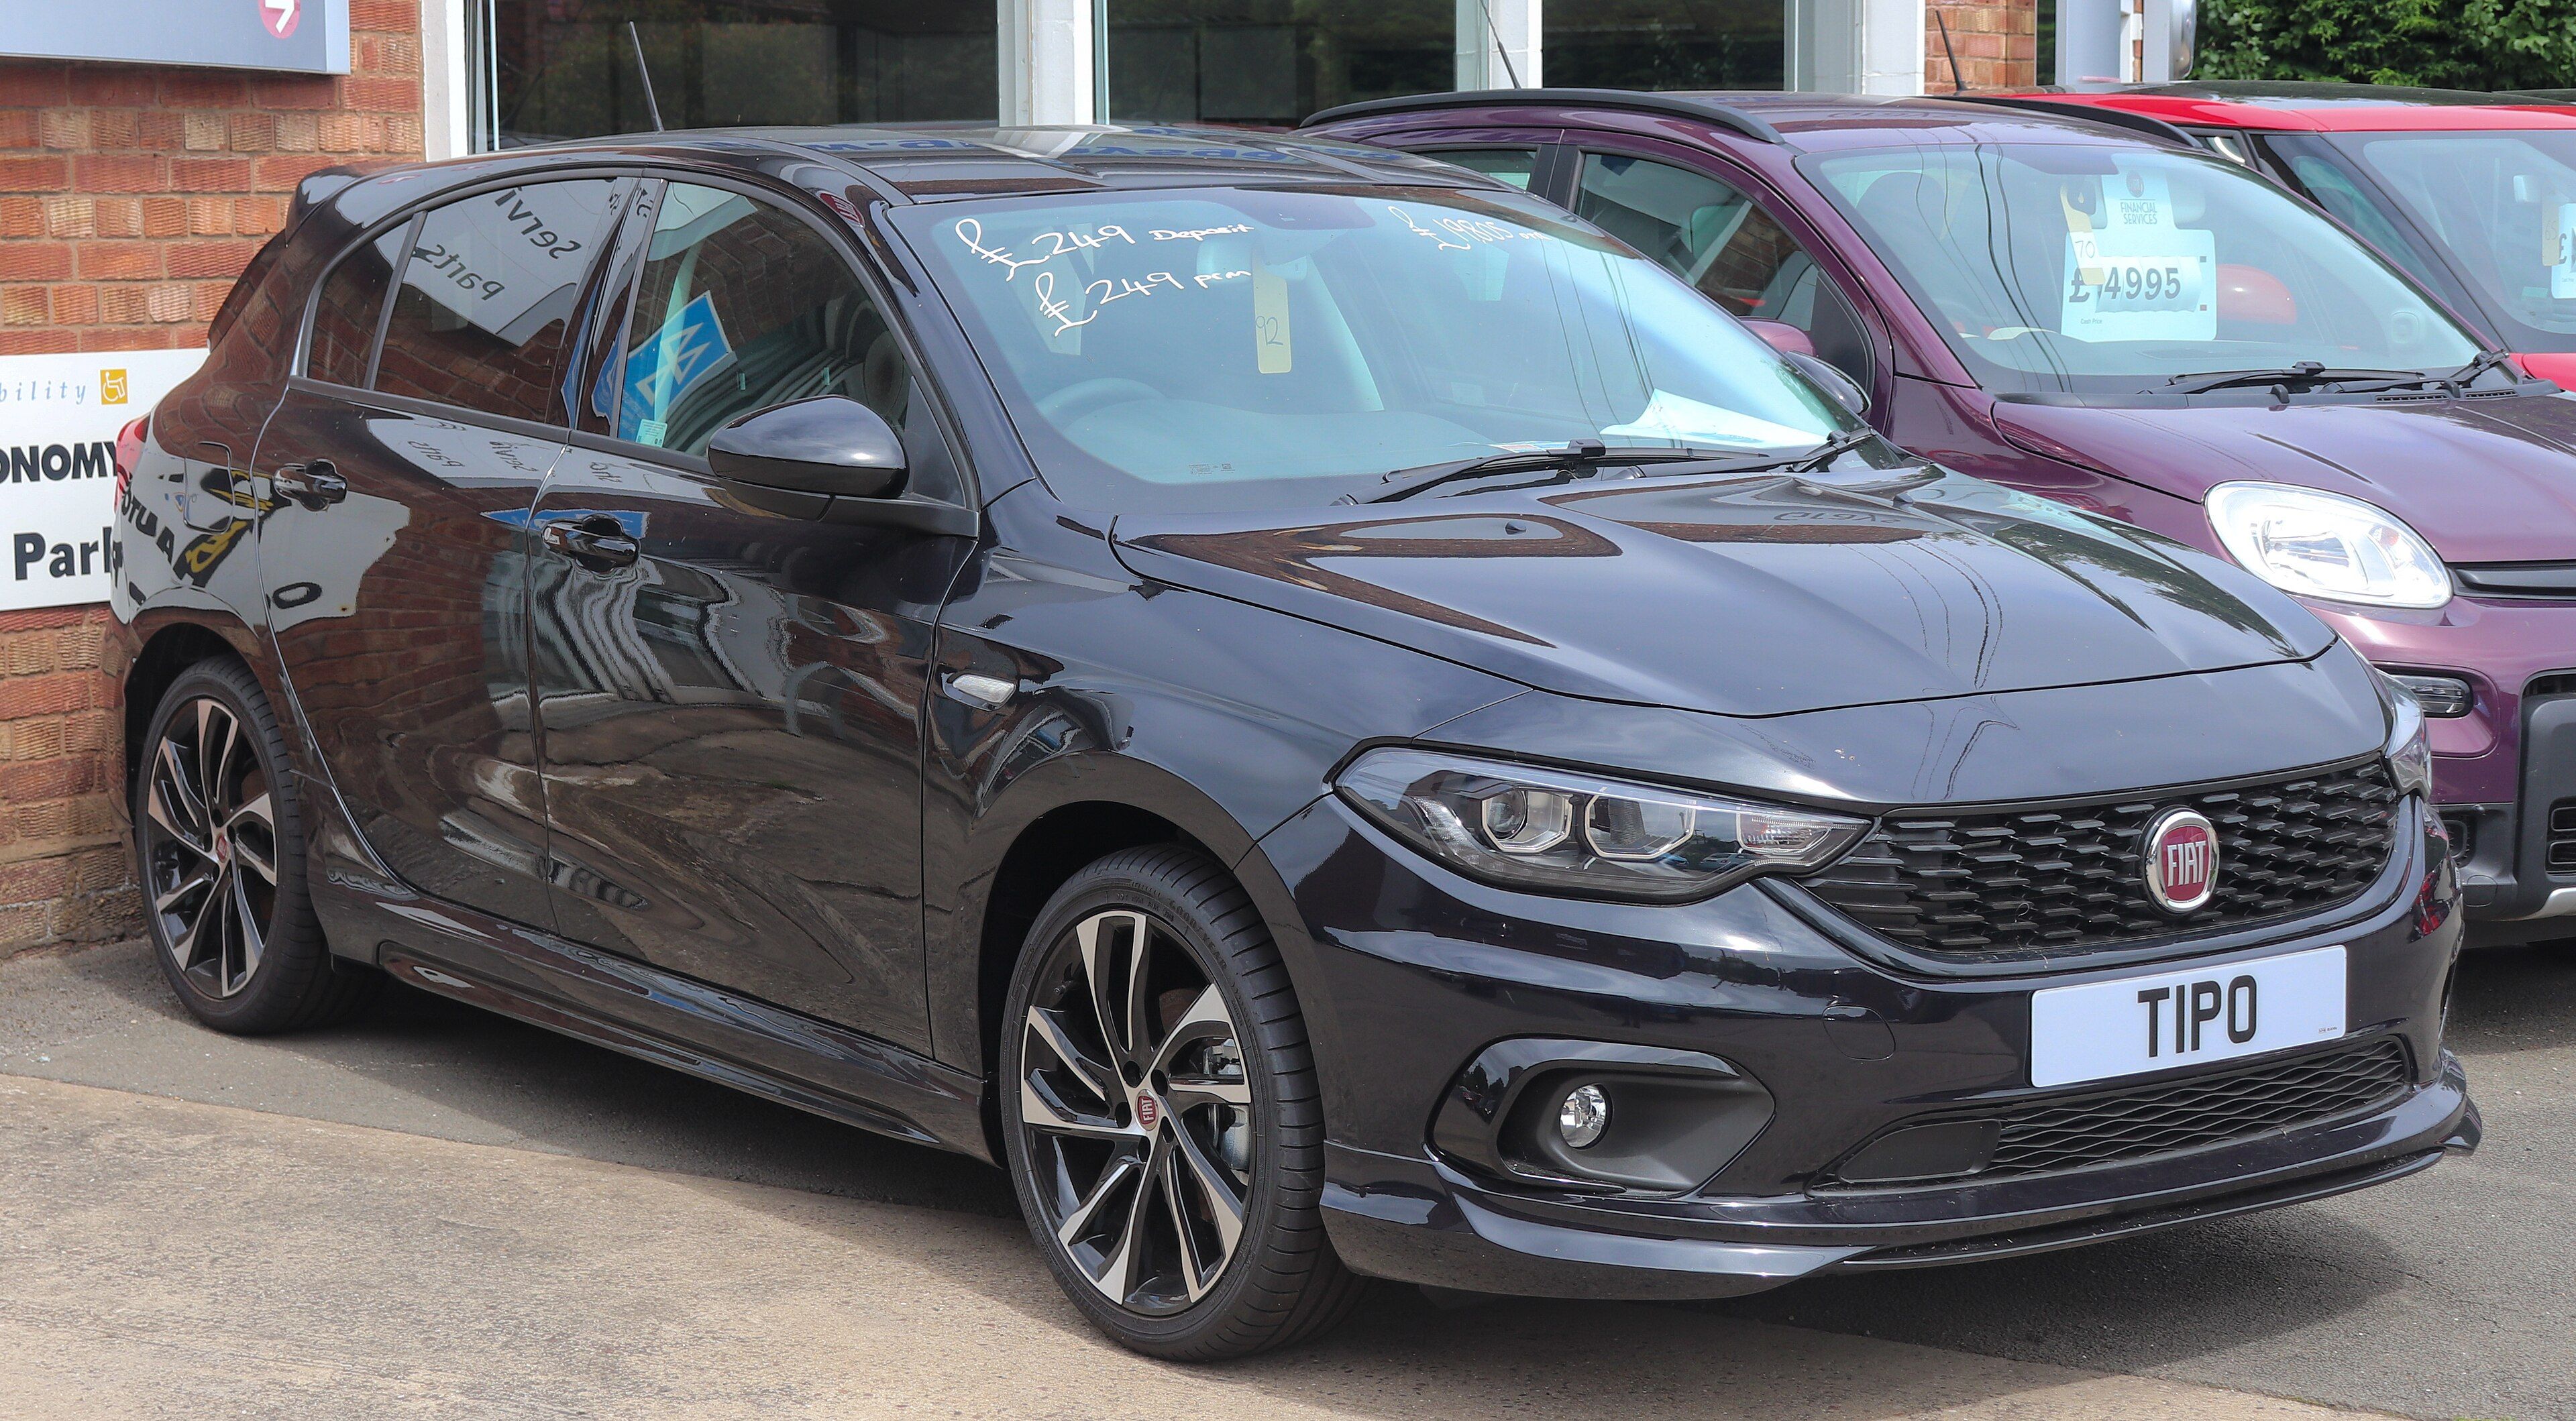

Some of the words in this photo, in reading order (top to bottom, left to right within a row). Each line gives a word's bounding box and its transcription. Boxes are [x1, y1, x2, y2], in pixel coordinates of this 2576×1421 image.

[2120, 202, 2158, 213] FINANCIAL
[2123, 213, 2158, 225] SERVICES
[1148, 224, 1254, 241] Deposit
[2075, 240, 2096, 259] 70
[1256, 315, 1283, 345] 92
[2167, 840, 2206, 888] FIAT
[2137, 974, 2257, 1059] TIPO
[1142, 1098, 1155, 1121] FIAT
